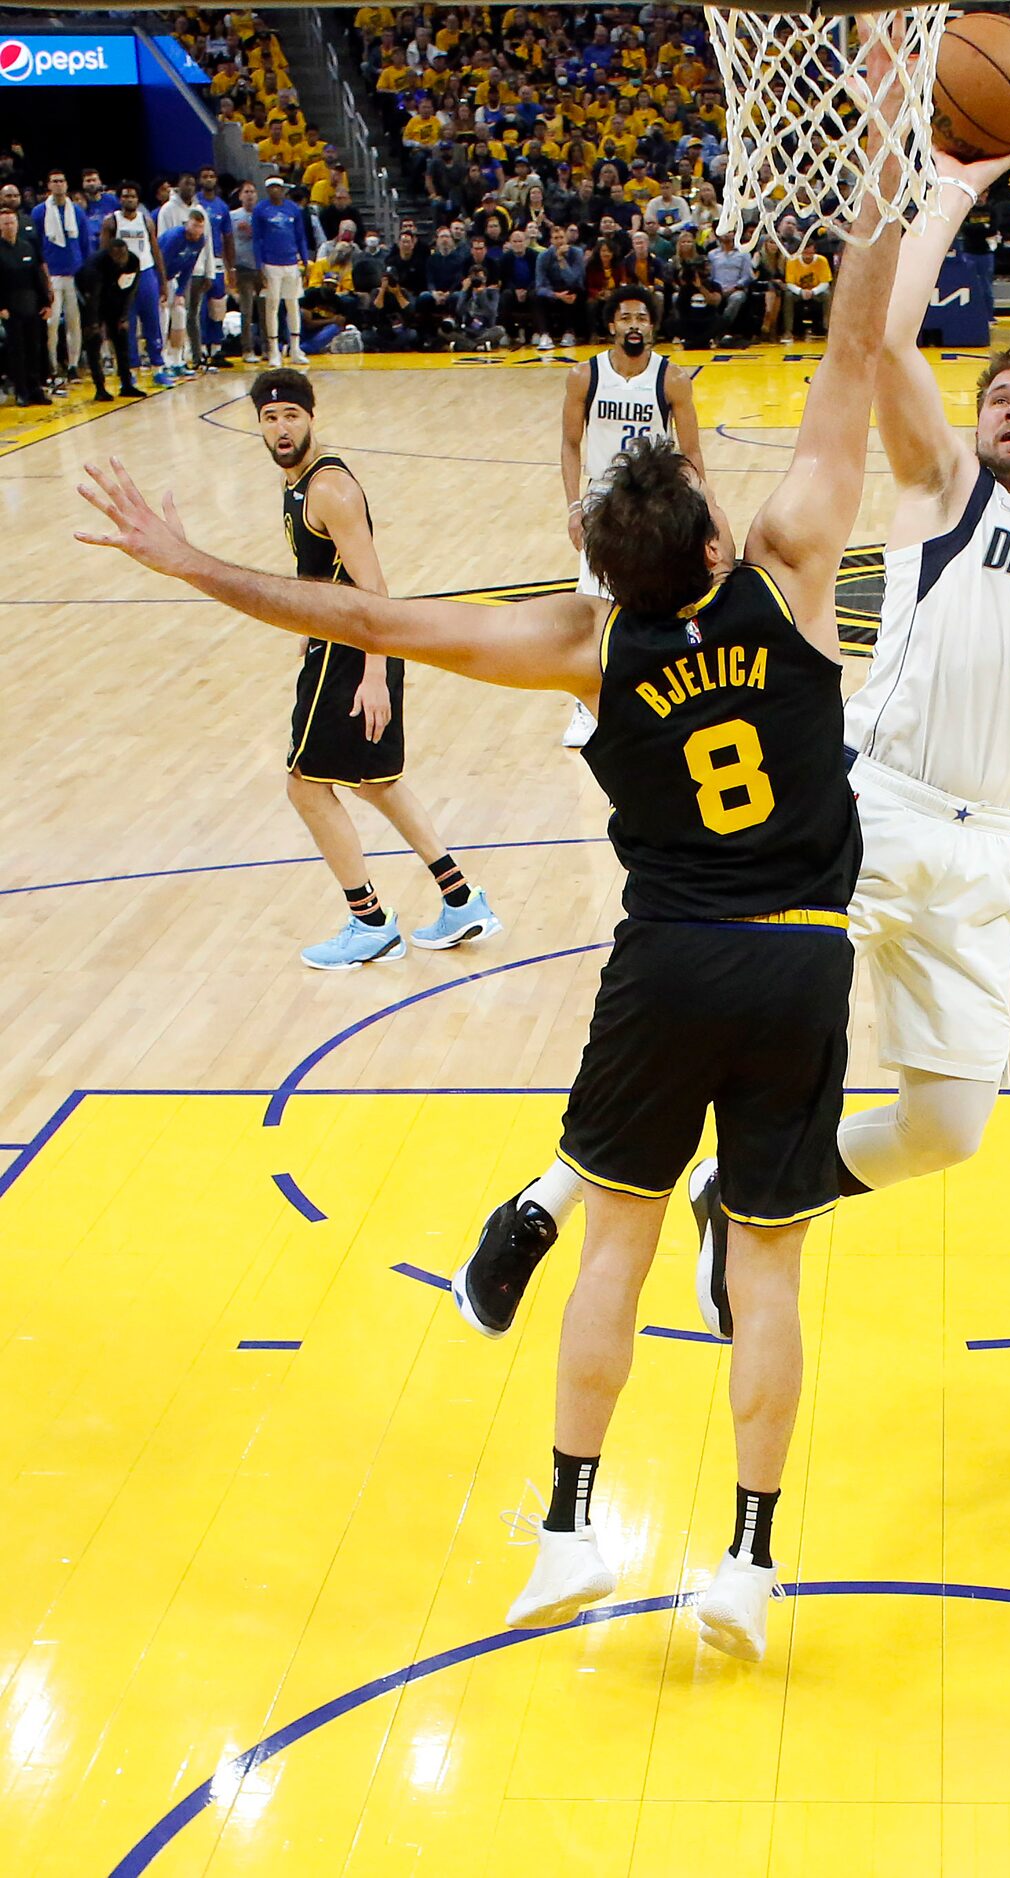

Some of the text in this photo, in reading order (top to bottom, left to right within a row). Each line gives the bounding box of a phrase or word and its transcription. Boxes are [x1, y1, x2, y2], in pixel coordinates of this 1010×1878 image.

[35, 46, 106, 76] pepsi
[597, 399, 654, 422] DALLAS
[635, 645, 769, 719] BJELICA
[683, 718, 775, 835] 8
